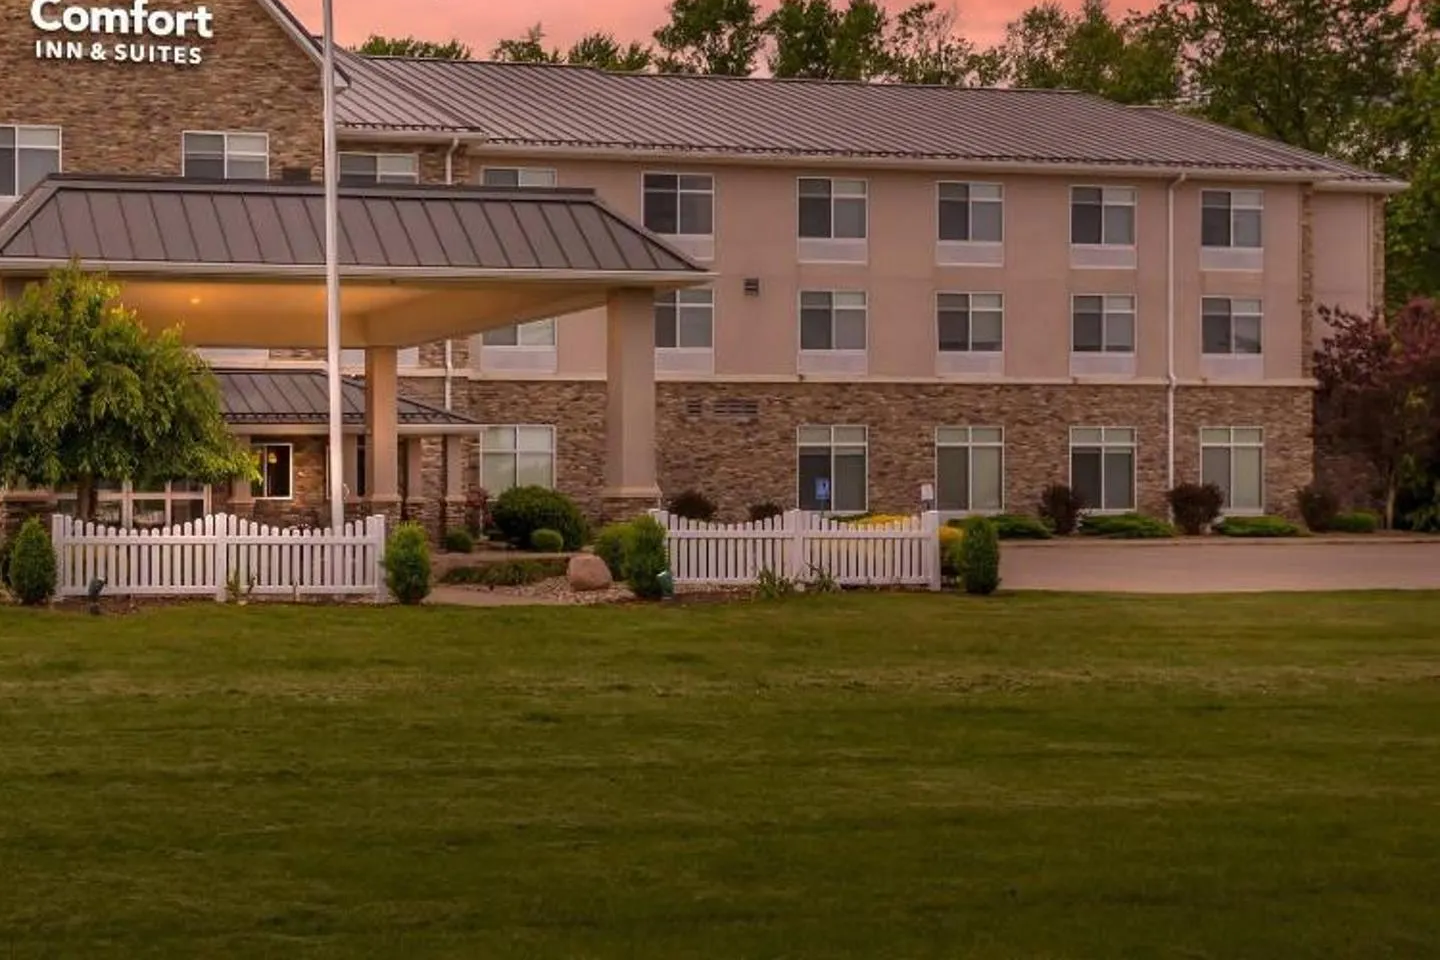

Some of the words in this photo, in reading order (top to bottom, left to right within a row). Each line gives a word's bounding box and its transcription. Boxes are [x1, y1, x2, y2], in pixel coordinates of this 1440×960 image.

[35, 40, 82, 59] INN
[90, 42, 107, 61] &
[114, 43, 202, 64] SUITES
